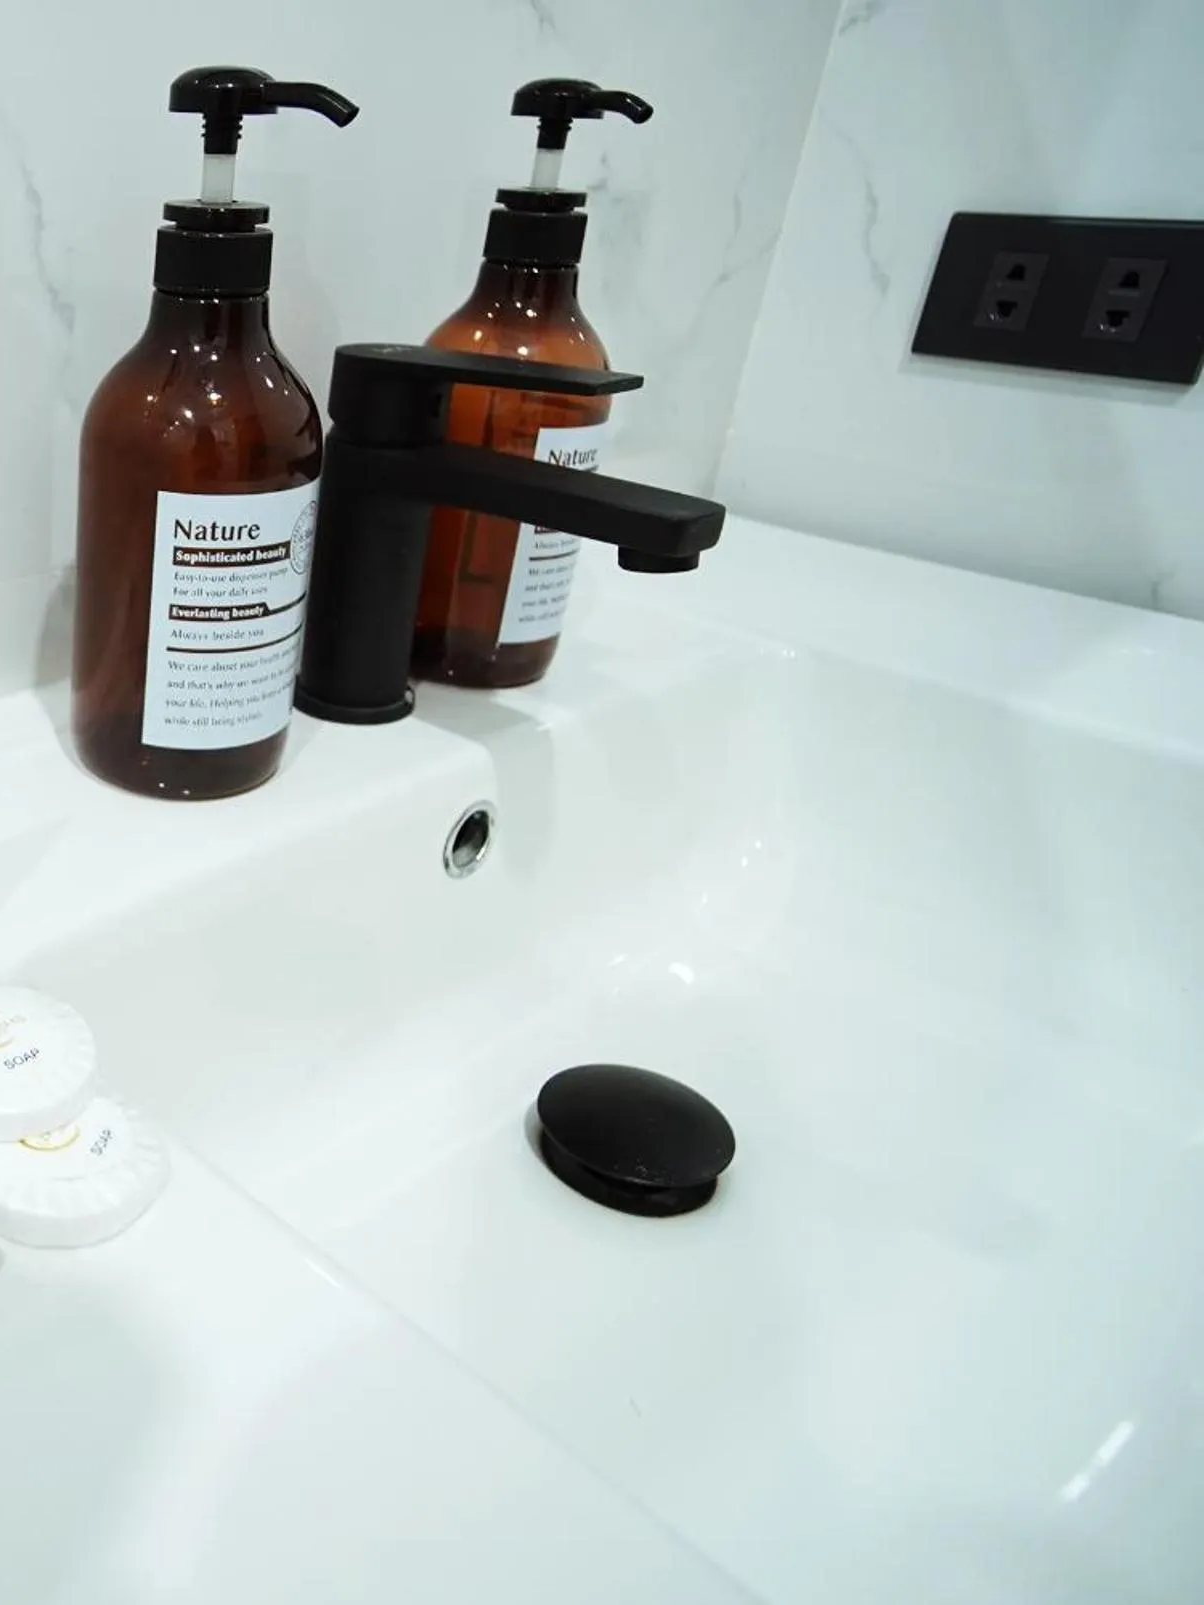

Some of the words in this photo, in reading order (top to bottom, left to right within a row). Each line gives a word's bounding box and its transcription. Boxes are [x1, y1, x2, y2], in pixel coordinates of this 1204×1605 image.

[173, 519, 261, 541] Nature
[175, 550, 254, 565] Sophisticated
[255, 546, 287, 561] beauty
[190, 587, 203, 597] all
[205, 589, 227, 599] your
[171, 606, 230, 620] Everlasting
[231, 605, 264, 618] beauty
[171, 629, 208, 641] Always
[212, 629, 245, 641] beside
[167, 680, 185, 690] and
[3, 1047, 41, 1070] SOAP
[89, 1128, 114, 1156] SOAP
